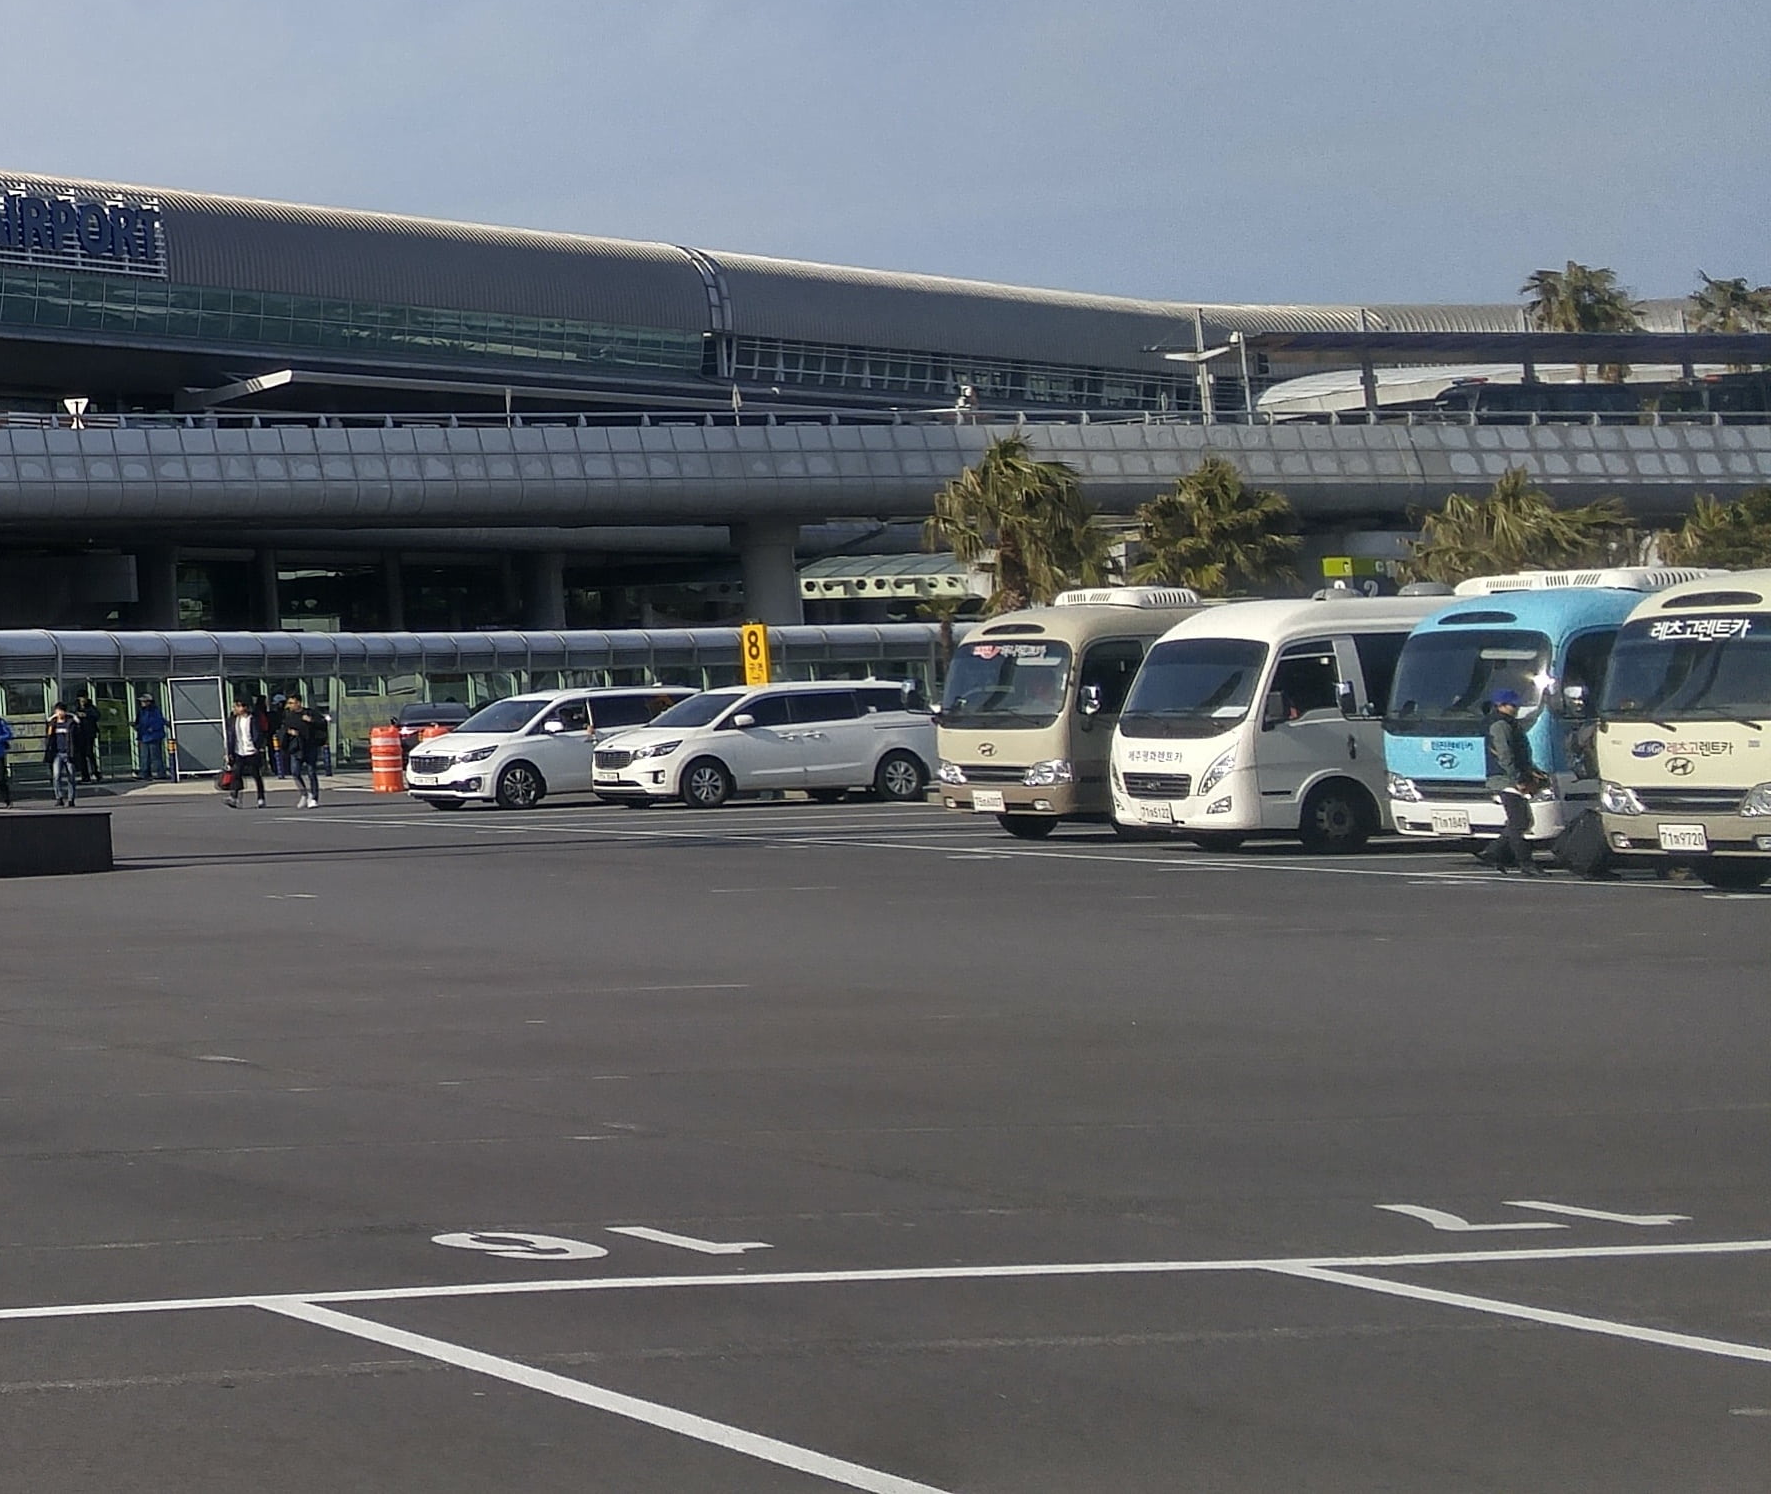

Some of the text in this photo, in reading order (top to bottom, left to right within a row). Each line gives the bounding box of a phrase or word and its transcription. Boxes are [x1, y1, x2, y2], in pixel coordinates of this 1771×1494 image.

[747, 630, 760, 660] 8
[1650, 619, 1752, 642] 레츠고렌트카
[1666, 741, 1734, 757] 레츠고렌트카
[1373, 1200, 1691, 1231] 17
[430, 1225, 775, 1260] 16
